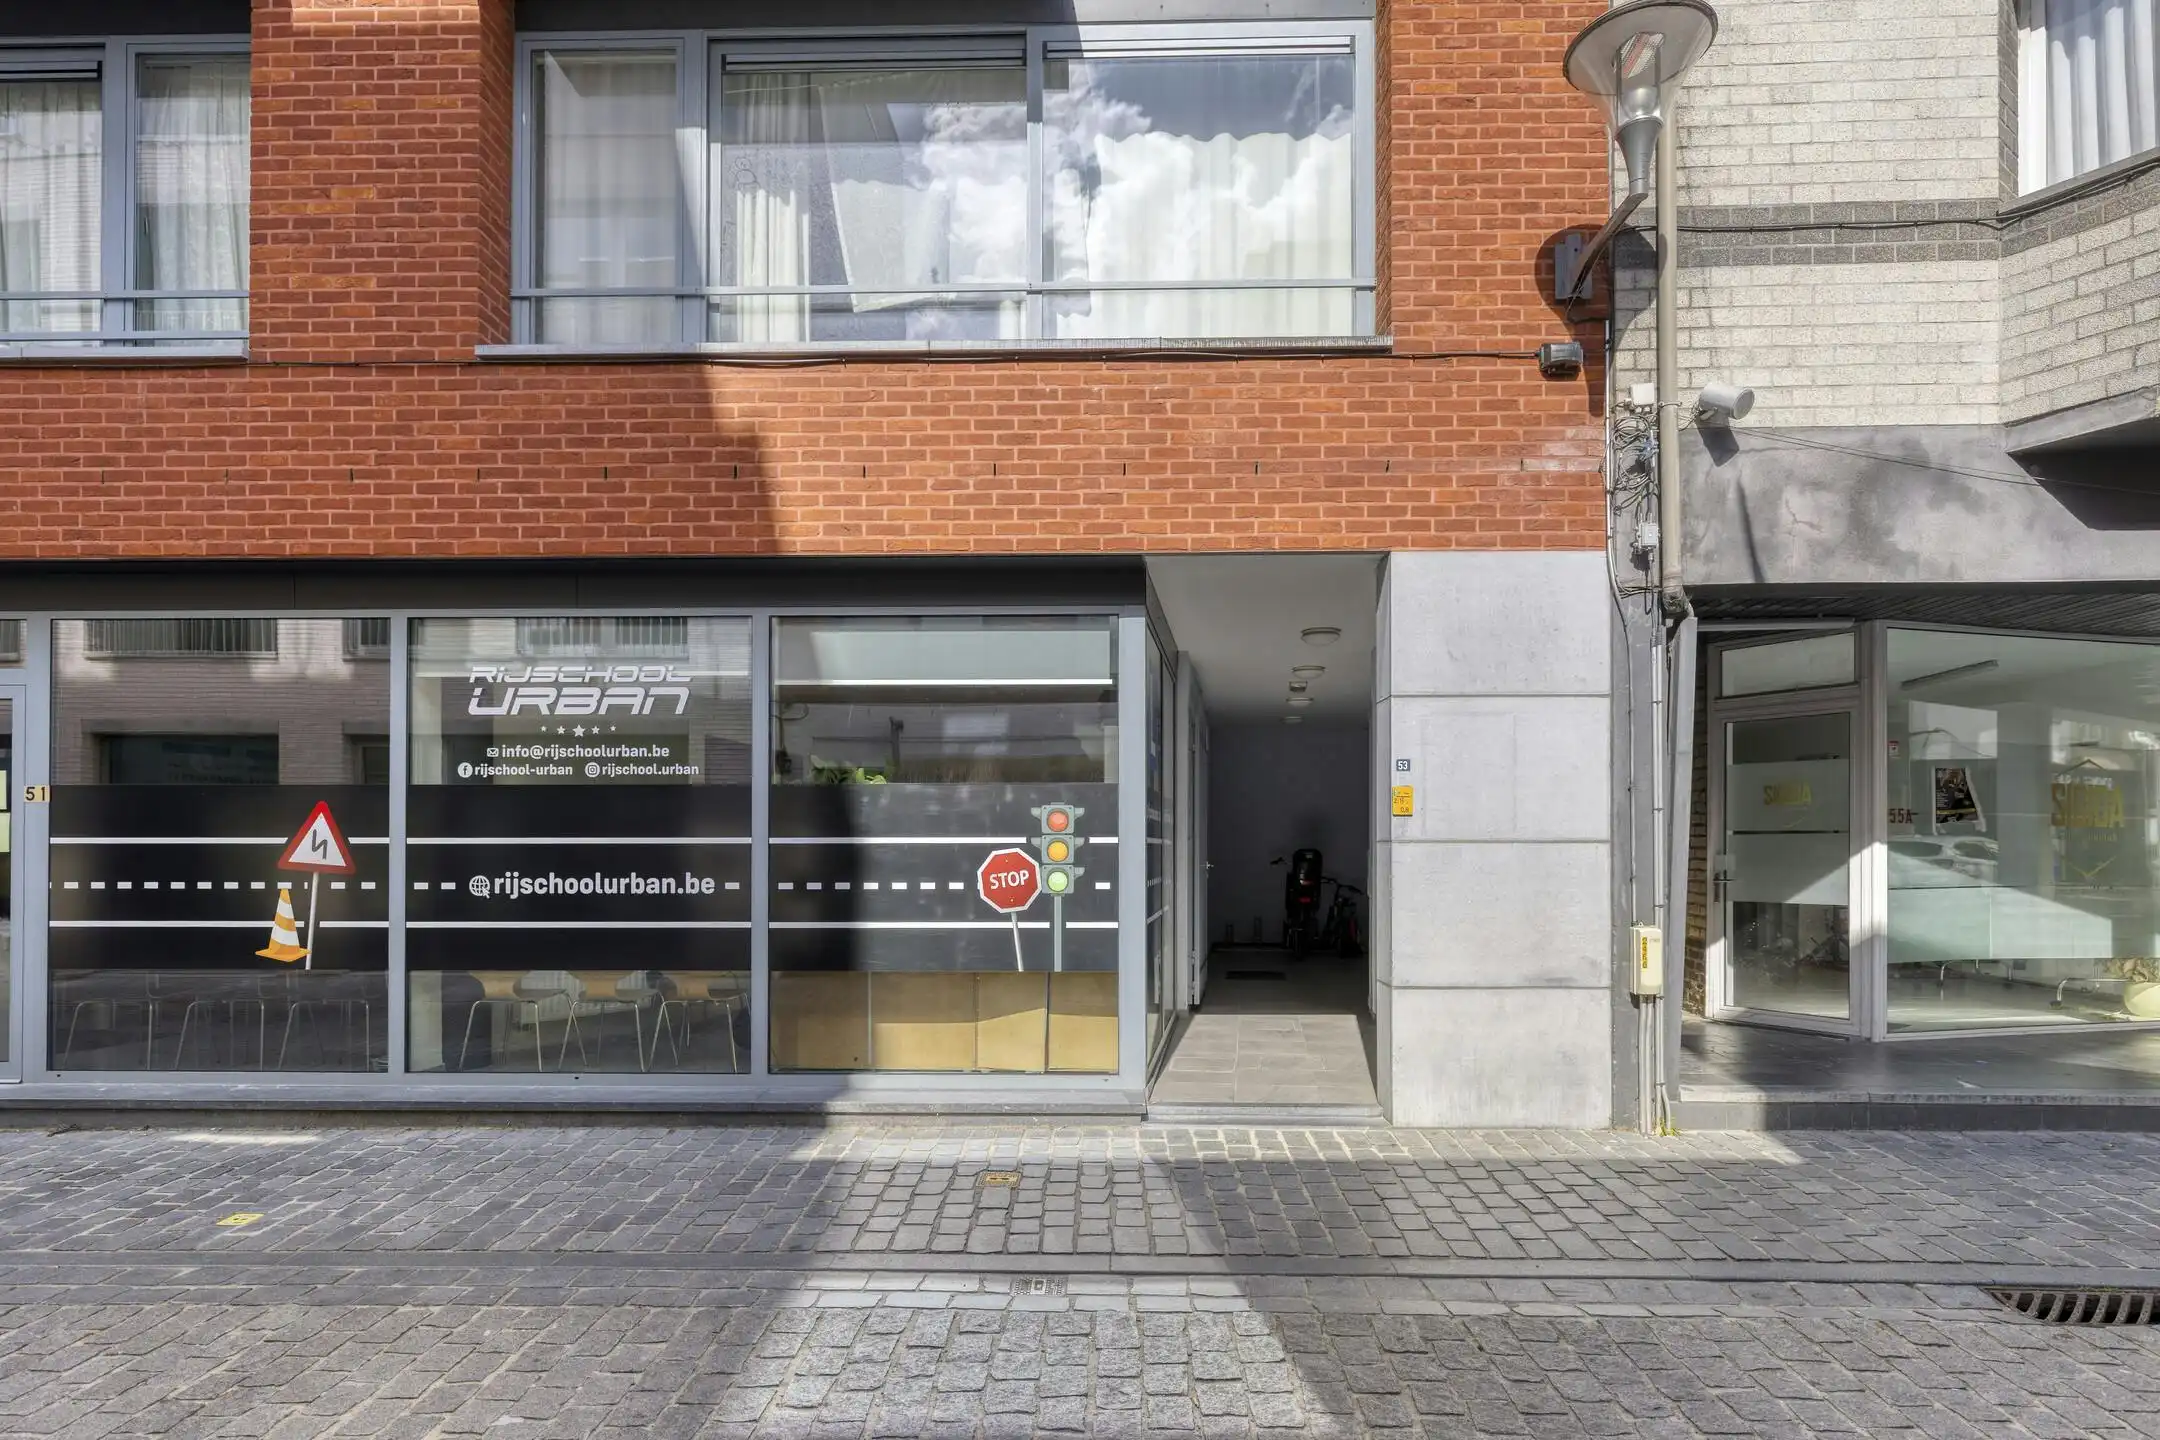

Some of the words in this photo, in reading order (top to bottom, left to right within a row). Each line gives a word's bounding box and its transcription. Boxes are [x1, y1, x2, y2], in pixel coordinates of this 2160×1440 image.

[468, 687, 690, 716] URBAN
[501, 744, 670, 760] info@rijschoolurban.be
[474, 764, 573, 777] rijschool-urban
[602, 763, 699, 777] rijschool.urban
[1398, 760, 1408, 770] 53
[25, 786, 46, 801] 51
[494, 871, 715, 899] rijschoolurban.be
[989, 869, 1030, 890] STOP
